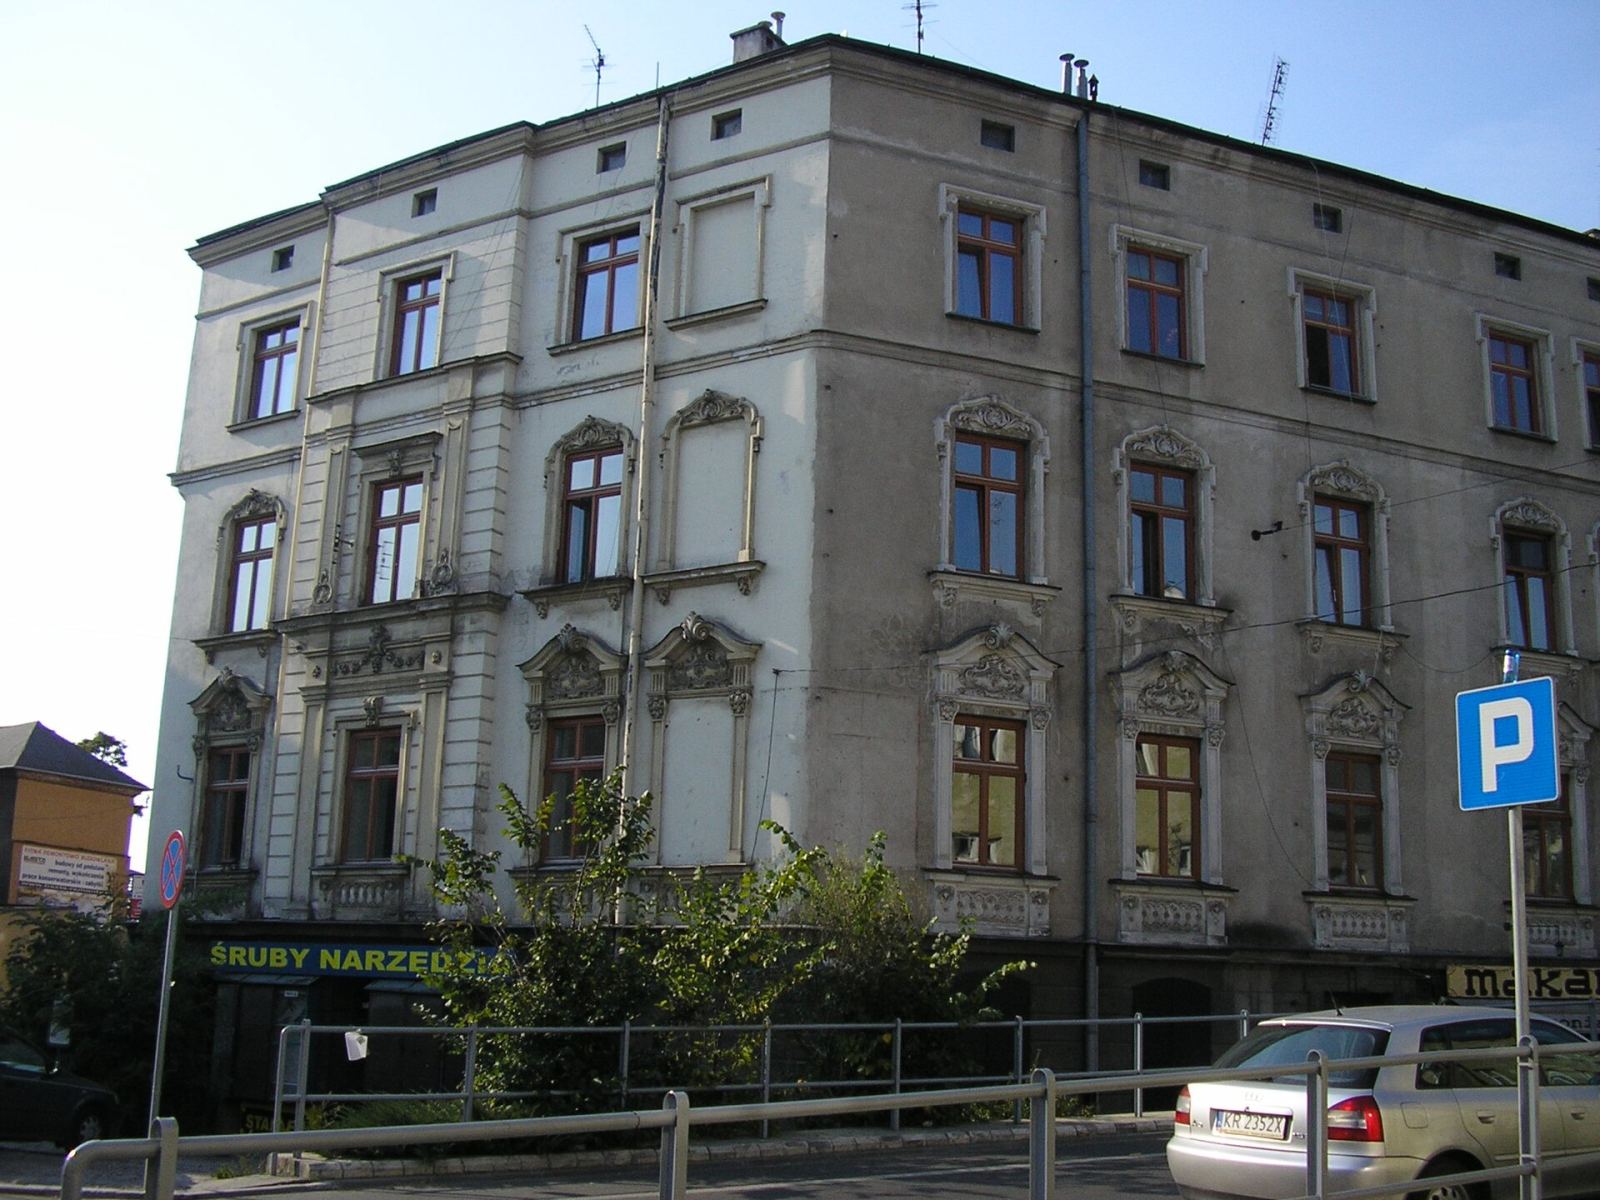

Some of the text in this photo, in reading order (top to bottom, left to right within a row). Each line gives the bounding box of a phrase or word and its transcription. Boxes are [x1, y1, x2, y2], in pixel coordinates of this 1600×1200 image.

[1479, 697, 1534, 792] P
[210, 941, 310, 968] ŚRUBY
[1223, 1111, 1241, 1128] KR
[1244, 1114, 1281, 1133] 2352X
